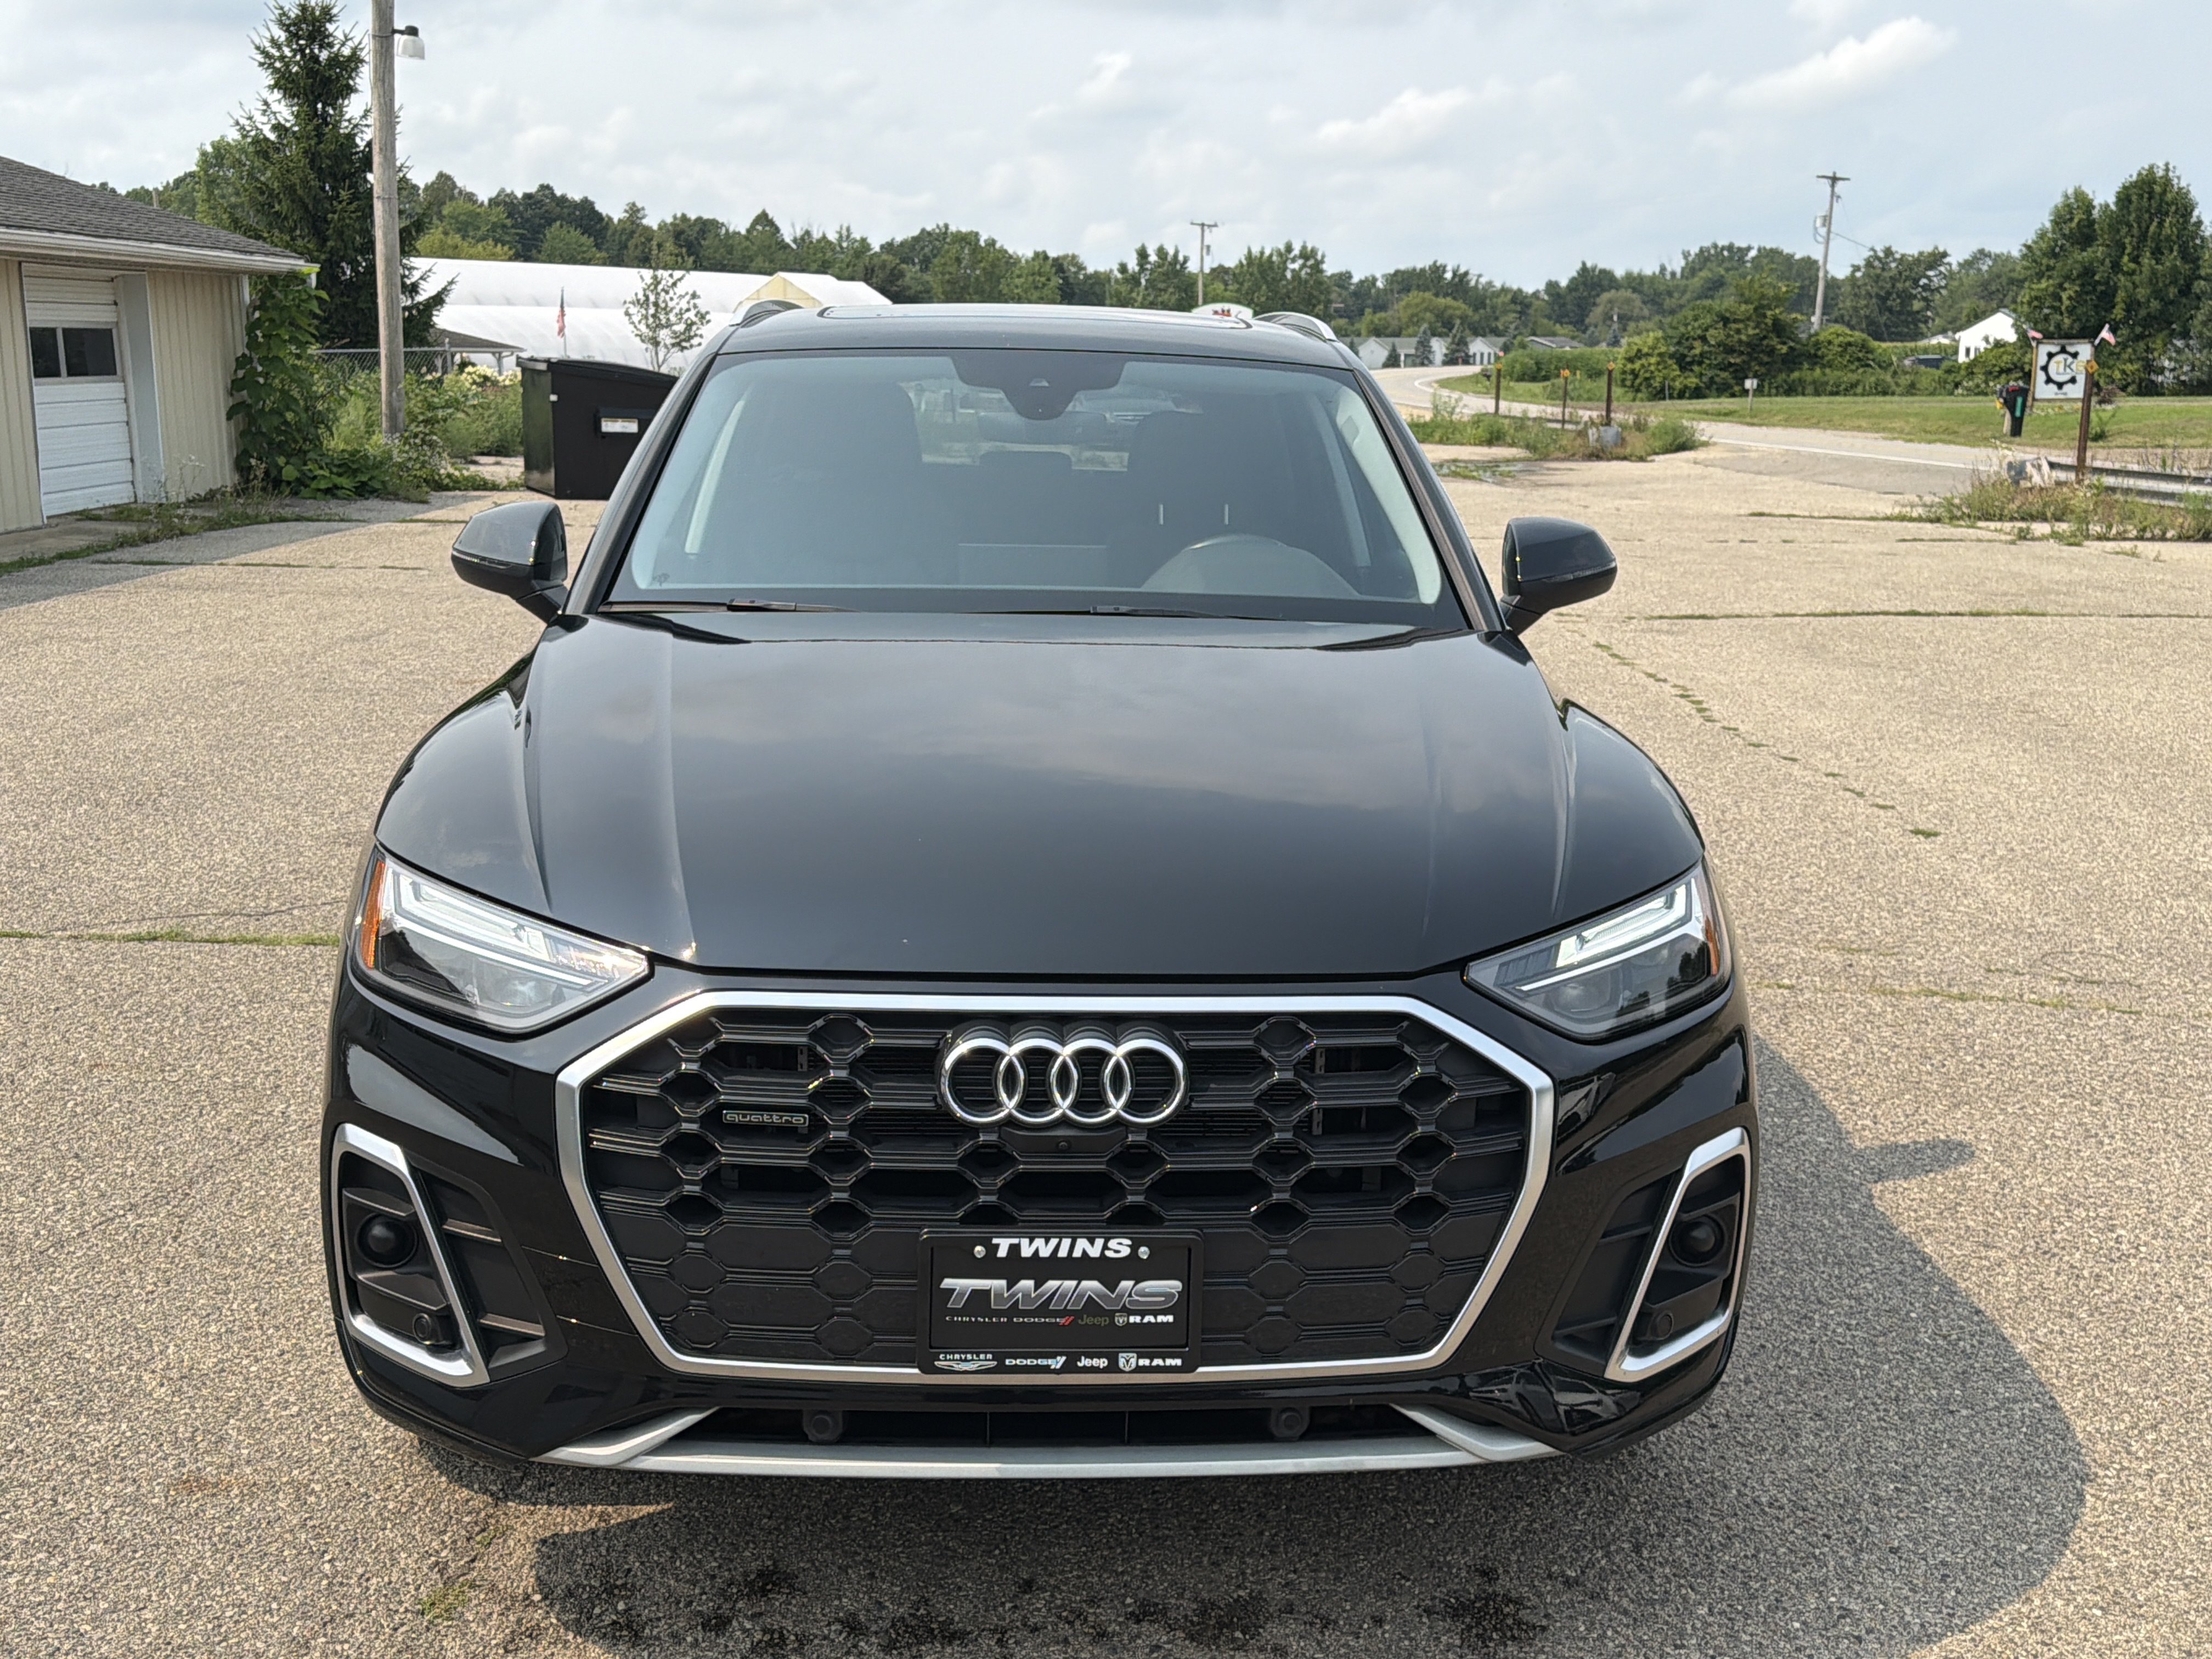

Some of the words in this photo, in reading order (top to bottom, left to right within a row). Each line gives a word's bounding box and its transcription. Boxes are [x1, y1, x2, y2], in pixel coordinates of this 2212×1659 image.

[726, 1114, 804, 1124] quattro
[992, 1238, 1132, 1257] TWINS
[940, 1278, 1183, 1310] TWINS
[1079, 1314, 1109, 1326] Jeep
[1077, 1356, 1108, 1369] Jeep
